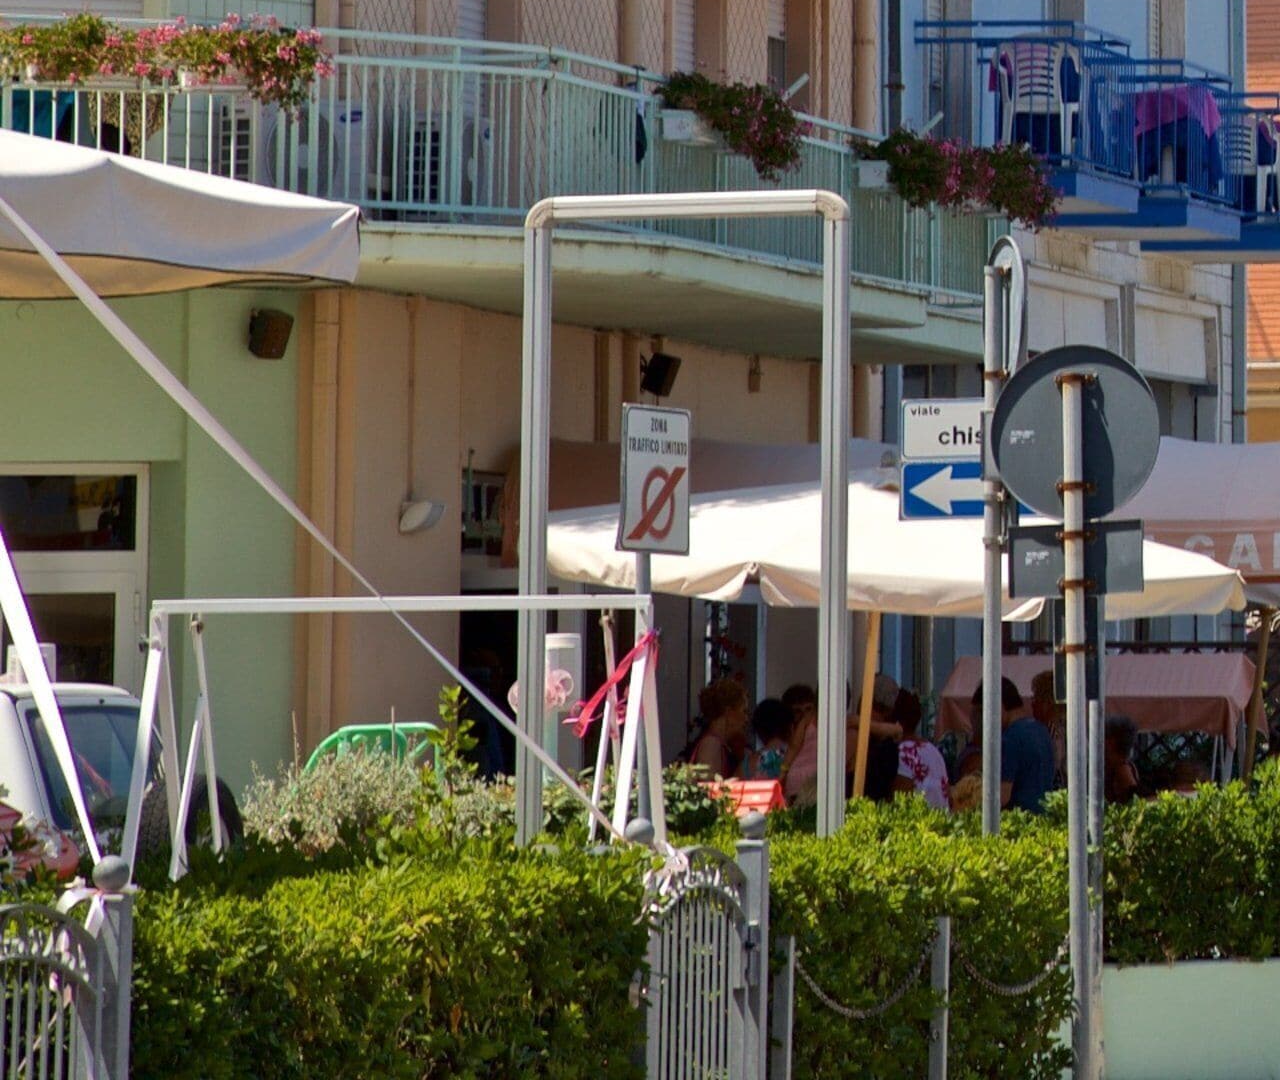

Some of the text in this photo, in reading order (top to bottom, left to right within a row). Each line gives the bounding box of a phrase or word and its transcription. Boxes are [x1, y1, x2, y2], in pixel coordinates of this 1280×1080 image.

[911, 405, 941, 416] viale
[651, 417, 668, 433] ZONA
[629, 436, 687, 457] TRAFFICO LIMITATO
